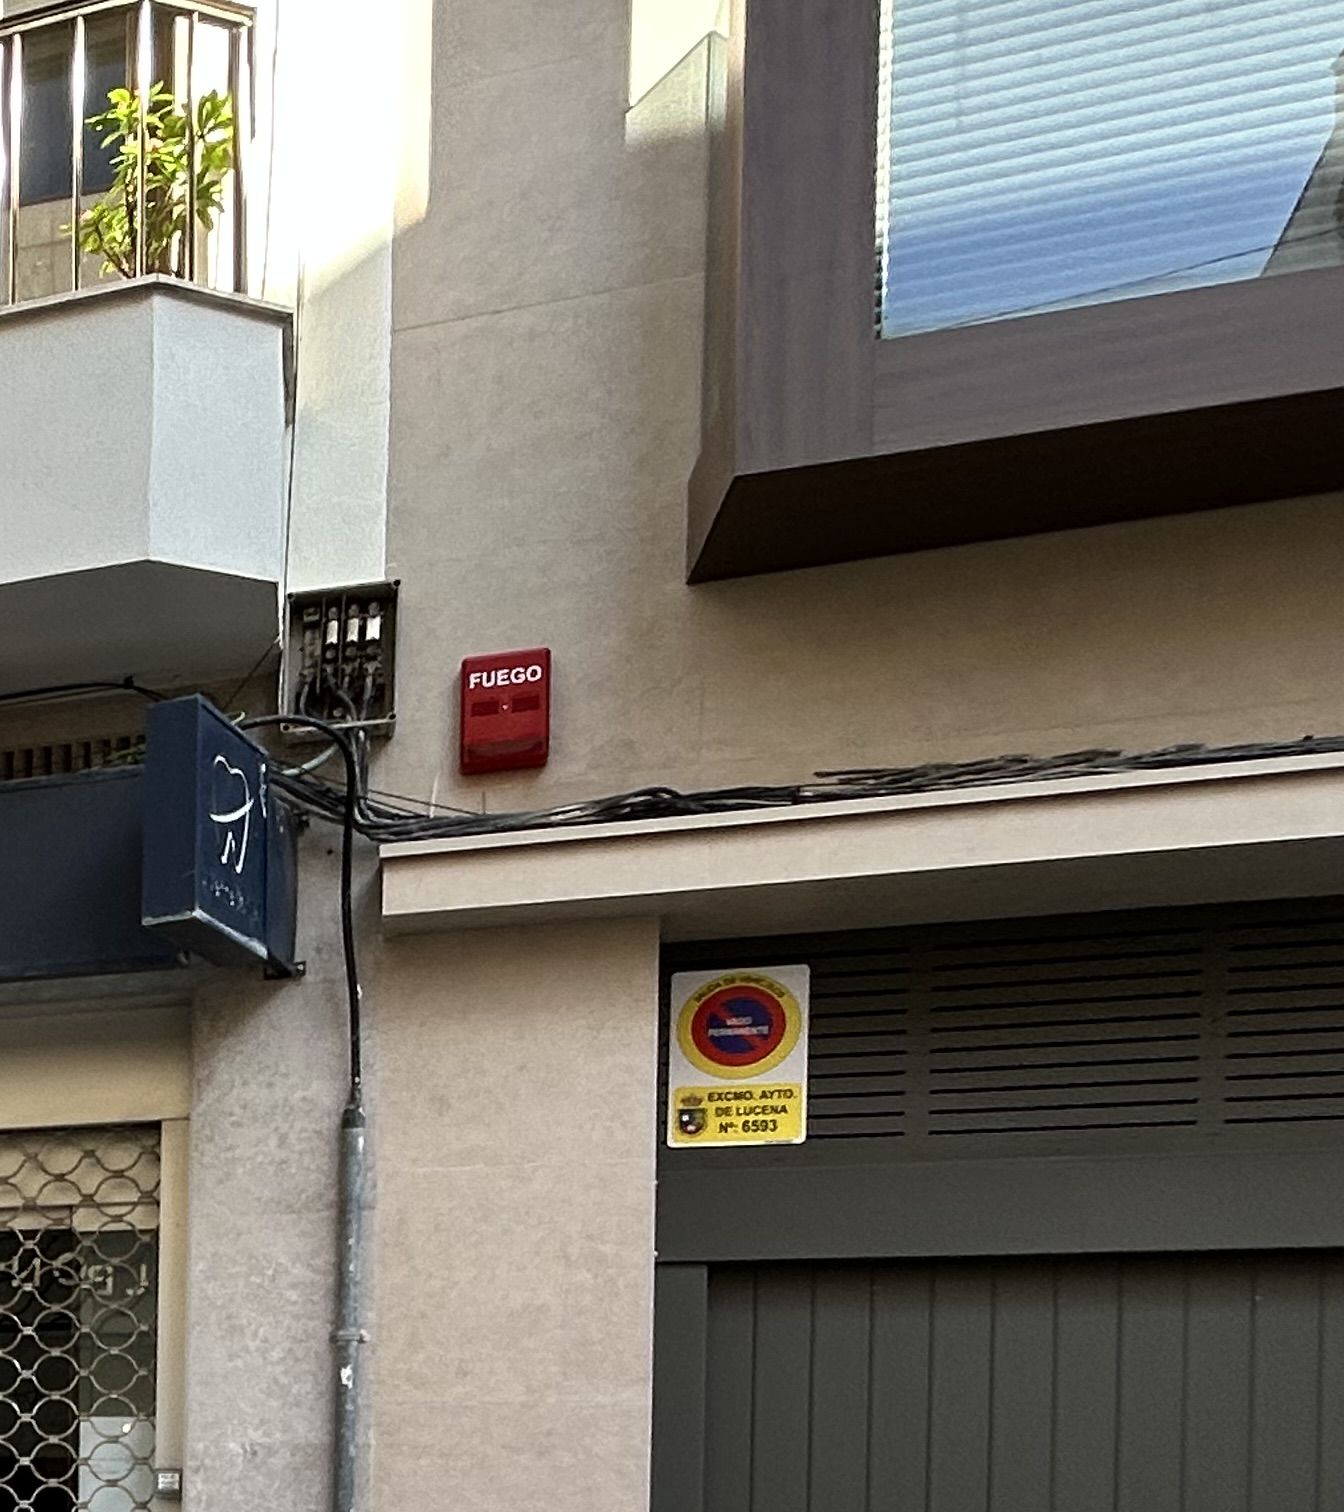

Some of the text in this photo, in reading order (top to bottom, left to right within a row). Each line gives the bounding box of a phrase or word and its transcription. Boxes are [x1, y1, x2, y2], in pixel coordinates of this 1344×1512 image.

[469, 665, 542, 689] FUEGO
[707, 1088, 798, 1103] EXCMO. AYTO.
[715, 1104, 789, 1118] DE LUCENA
[741, 1118, 779, 1133] 6593
